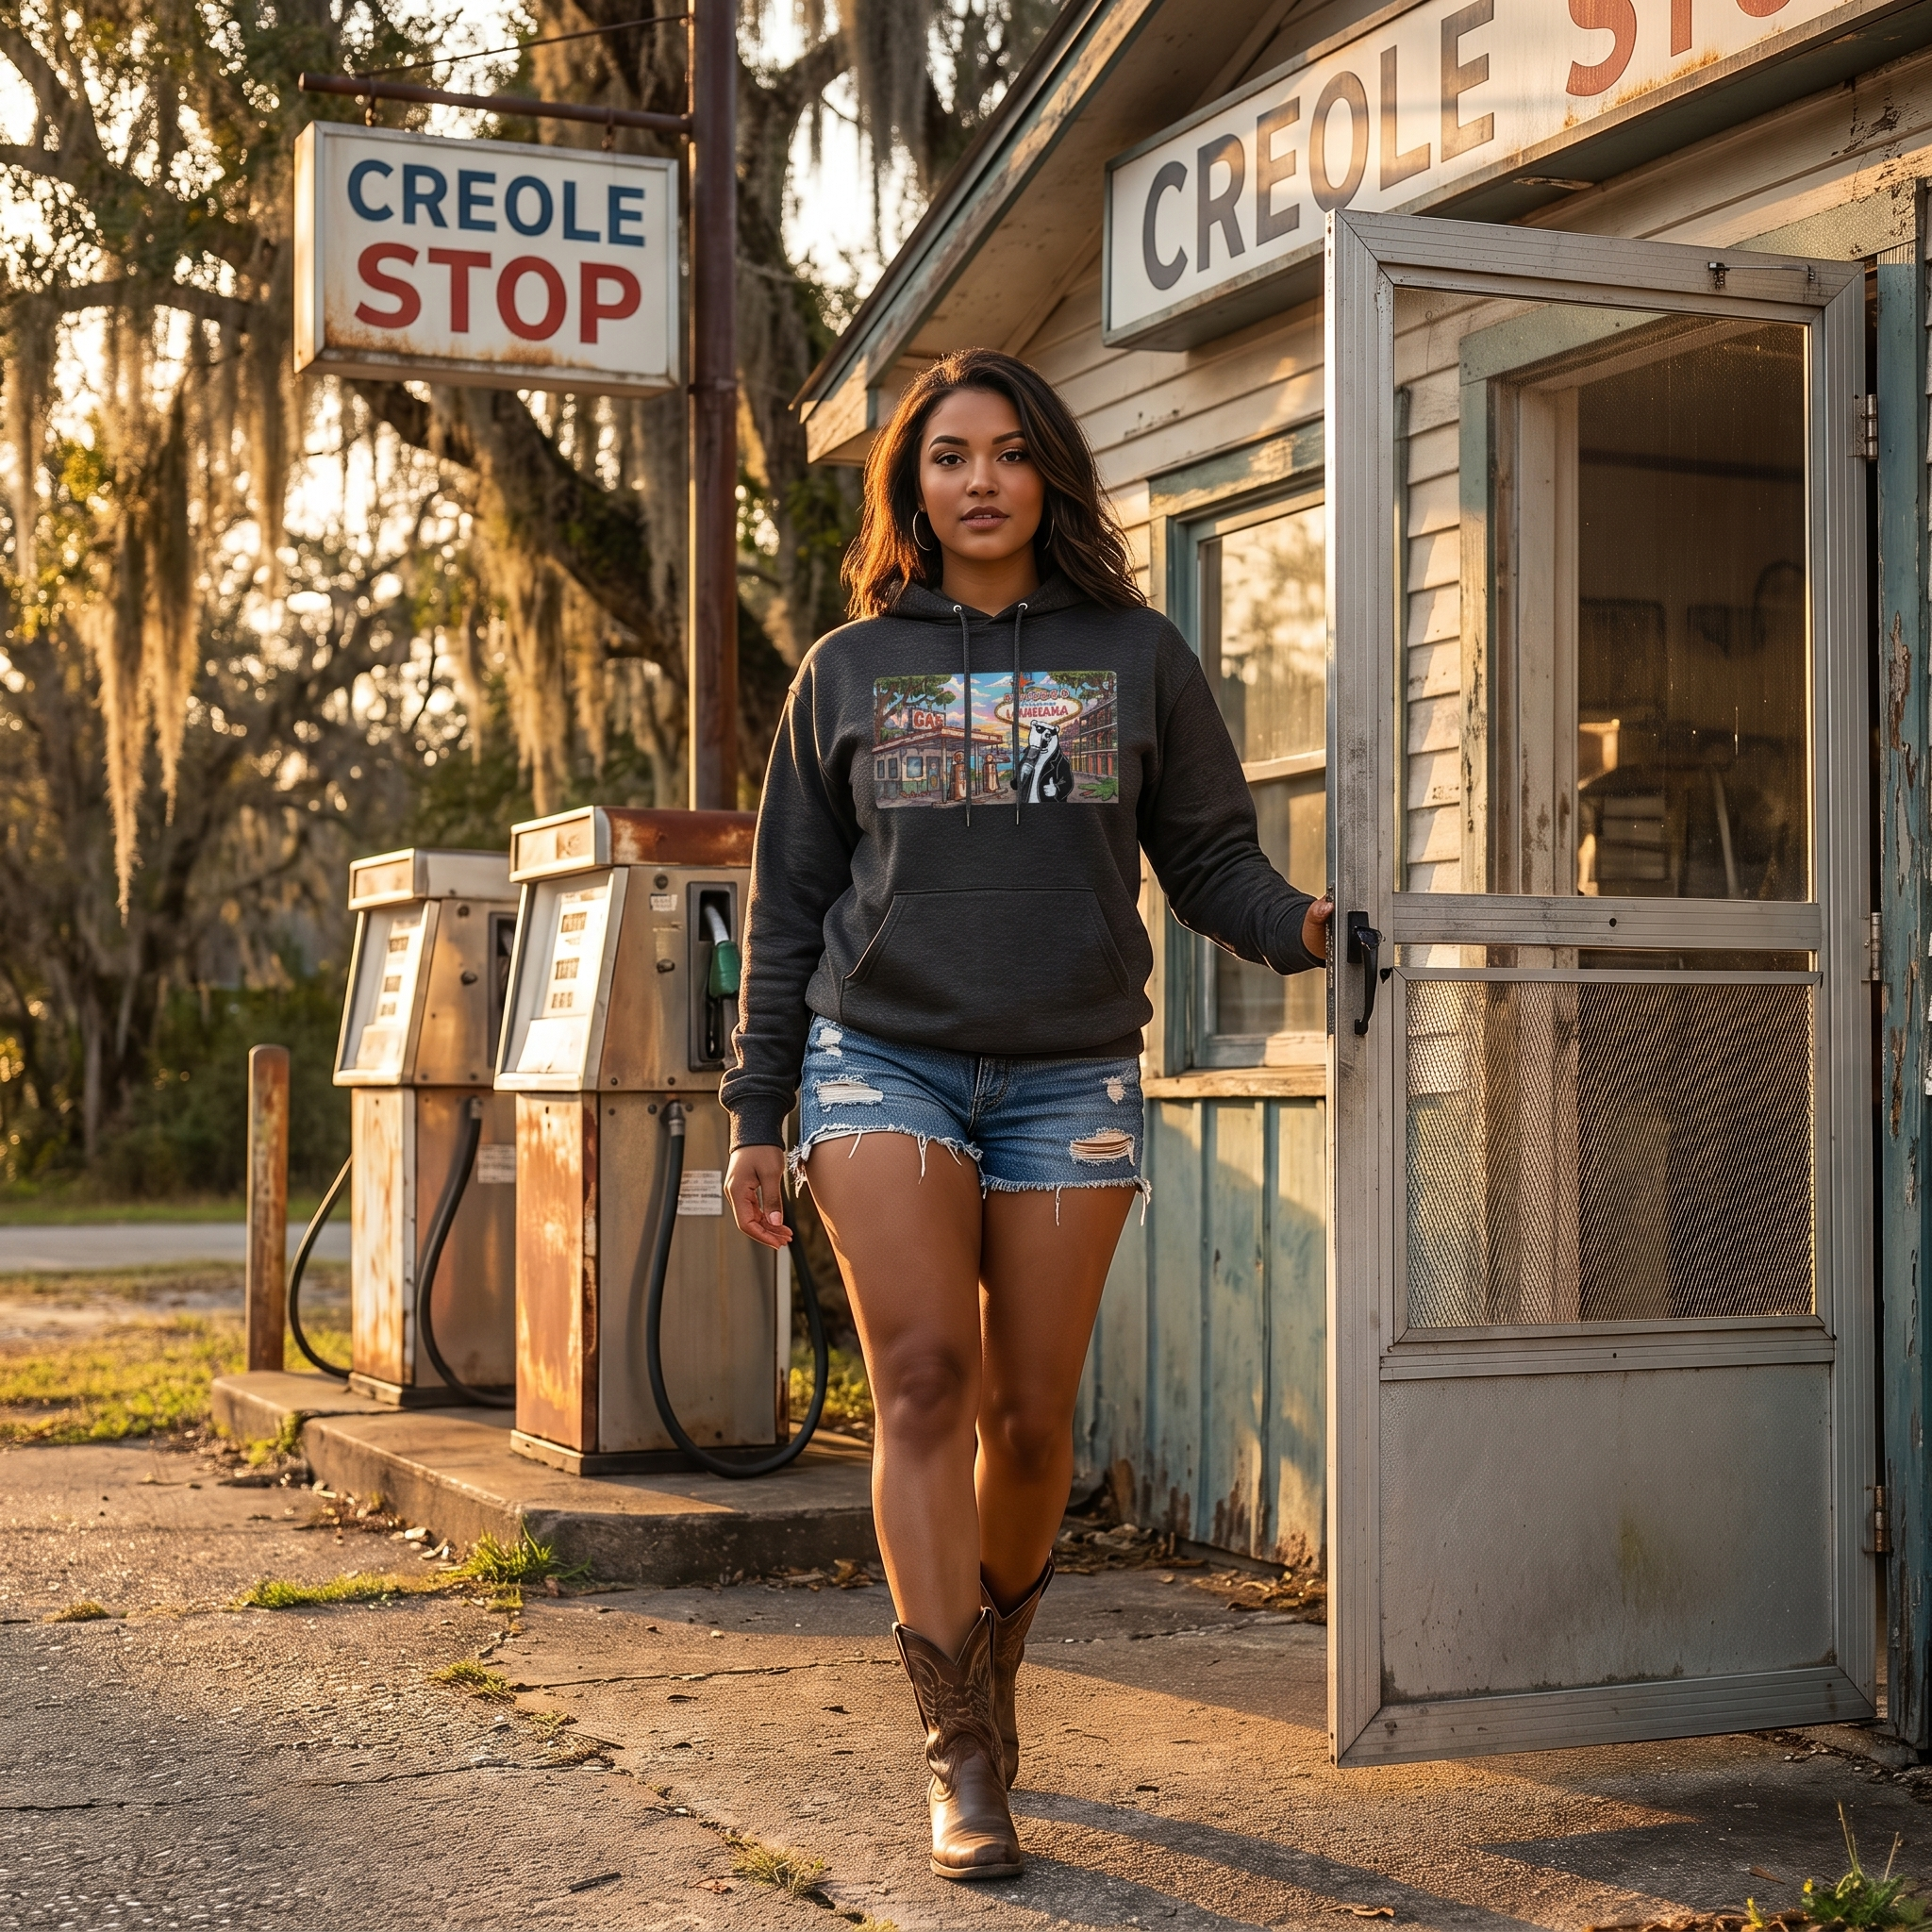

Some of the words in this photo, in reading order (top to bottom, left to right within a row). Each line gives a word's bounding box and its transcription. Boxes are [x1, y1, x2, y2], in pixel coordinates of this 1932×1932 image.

[1142, 0, 1494, 291] CREOLE
[347, 159, 645, 247] CREOLE
[355, 242, 641, 344] STOP
